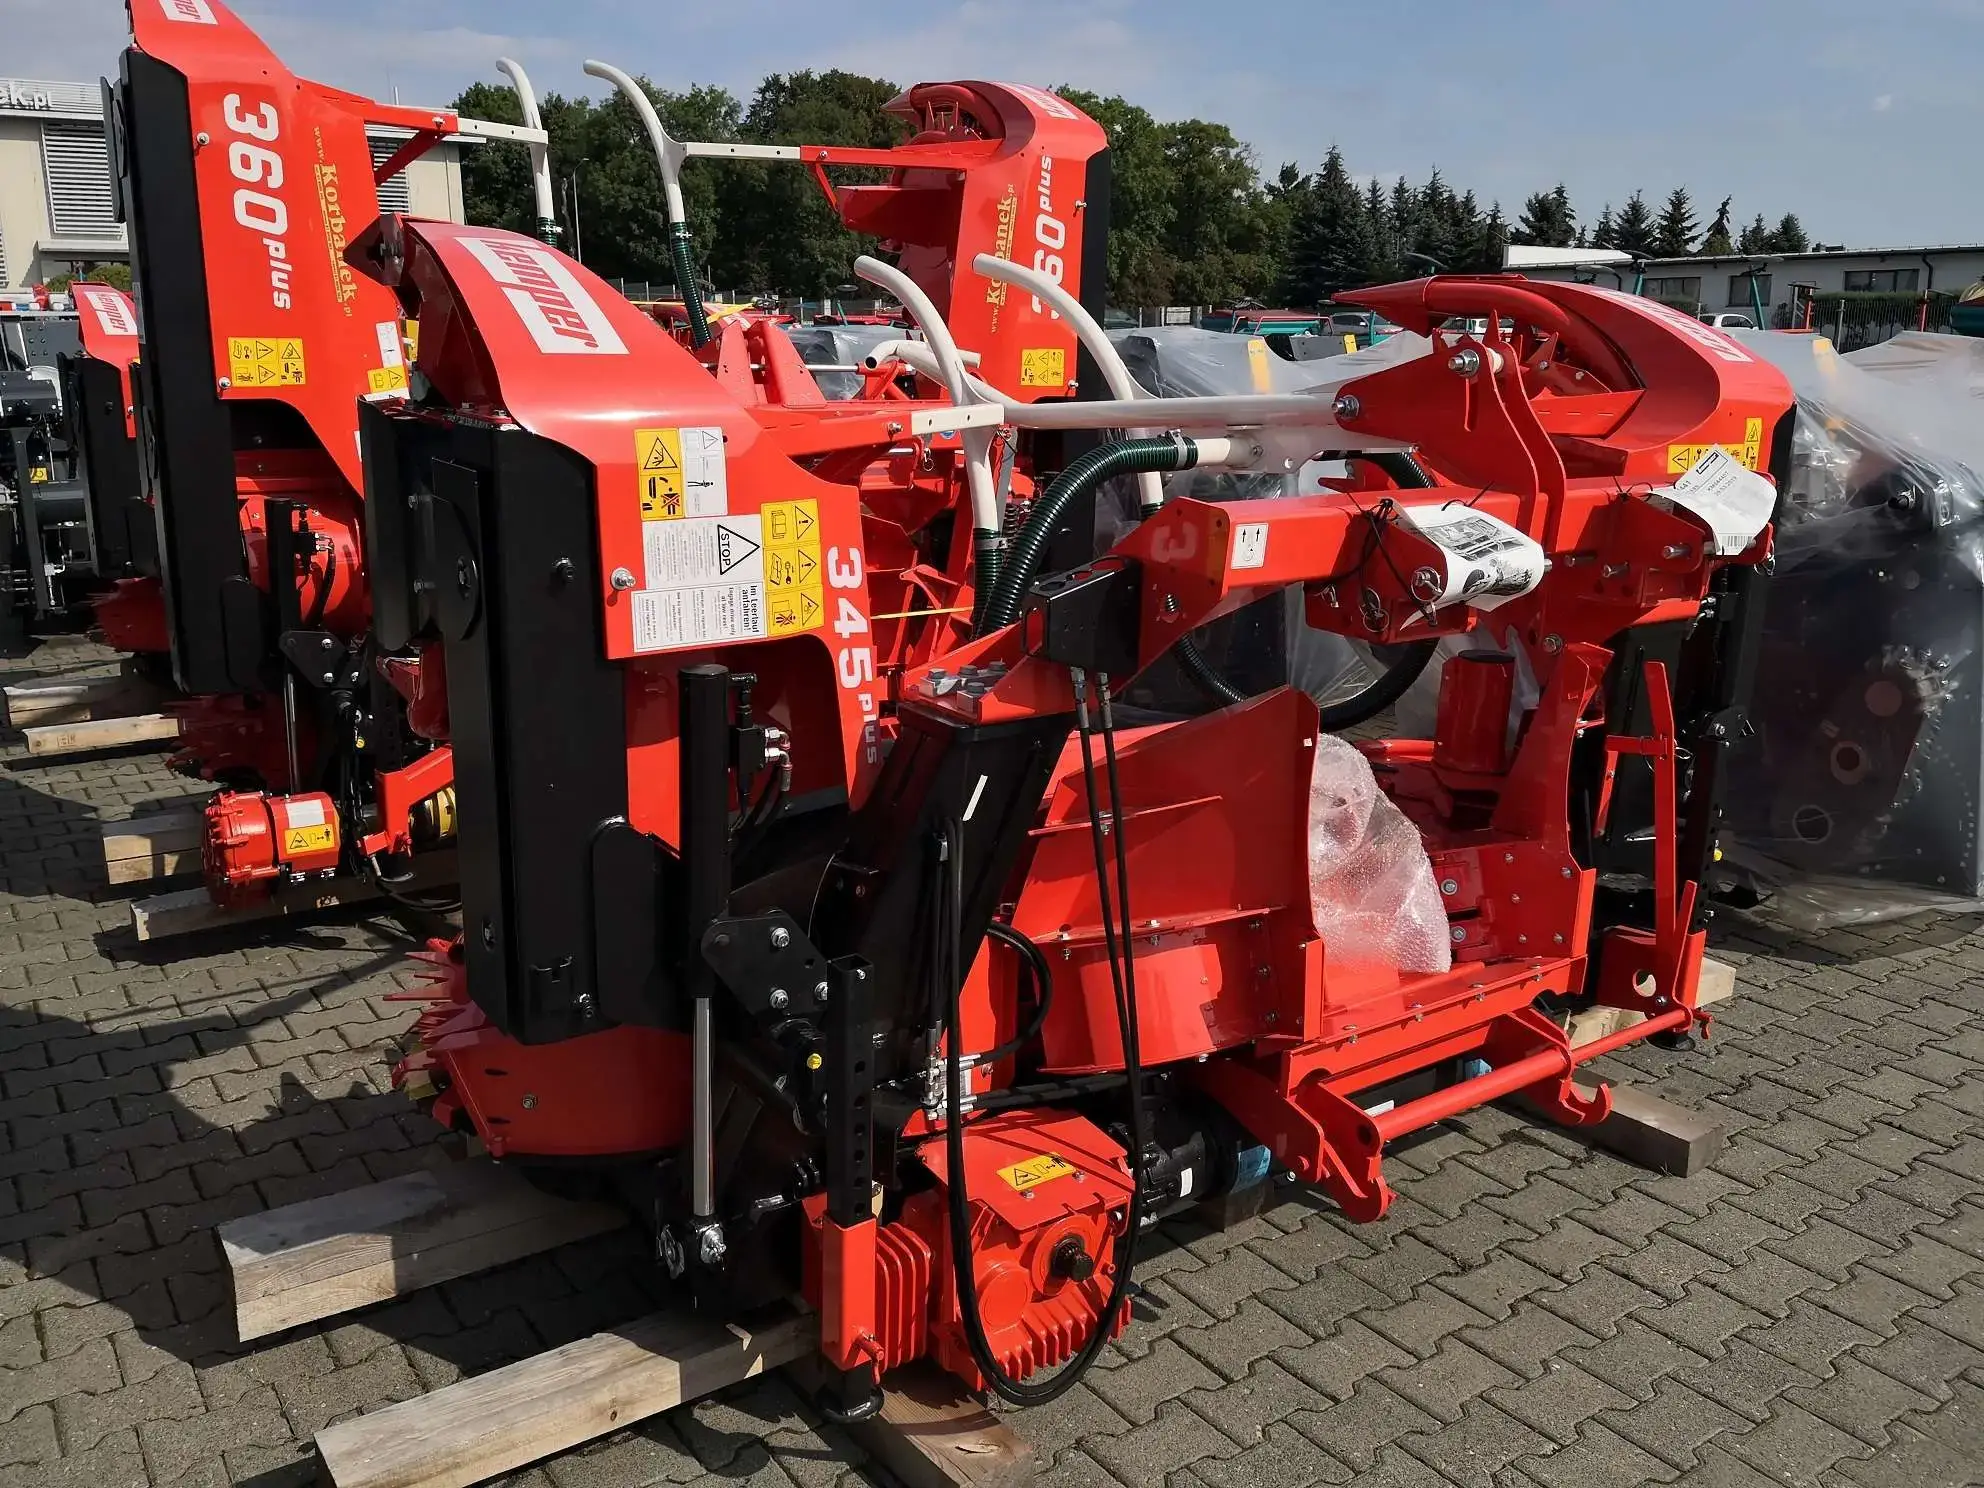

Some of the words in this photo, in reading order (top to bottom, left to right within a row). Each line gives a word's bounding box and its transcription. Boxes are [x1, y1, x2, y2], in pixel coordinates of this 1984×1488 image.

[479, 239, 600, 348] kemper
[720, 533, 731, 567] STOP
[750, 585, 758, 596] Im
[742, 589, 751, 631] anfahren!
[750, 598, 760, 633] Leerlauf
